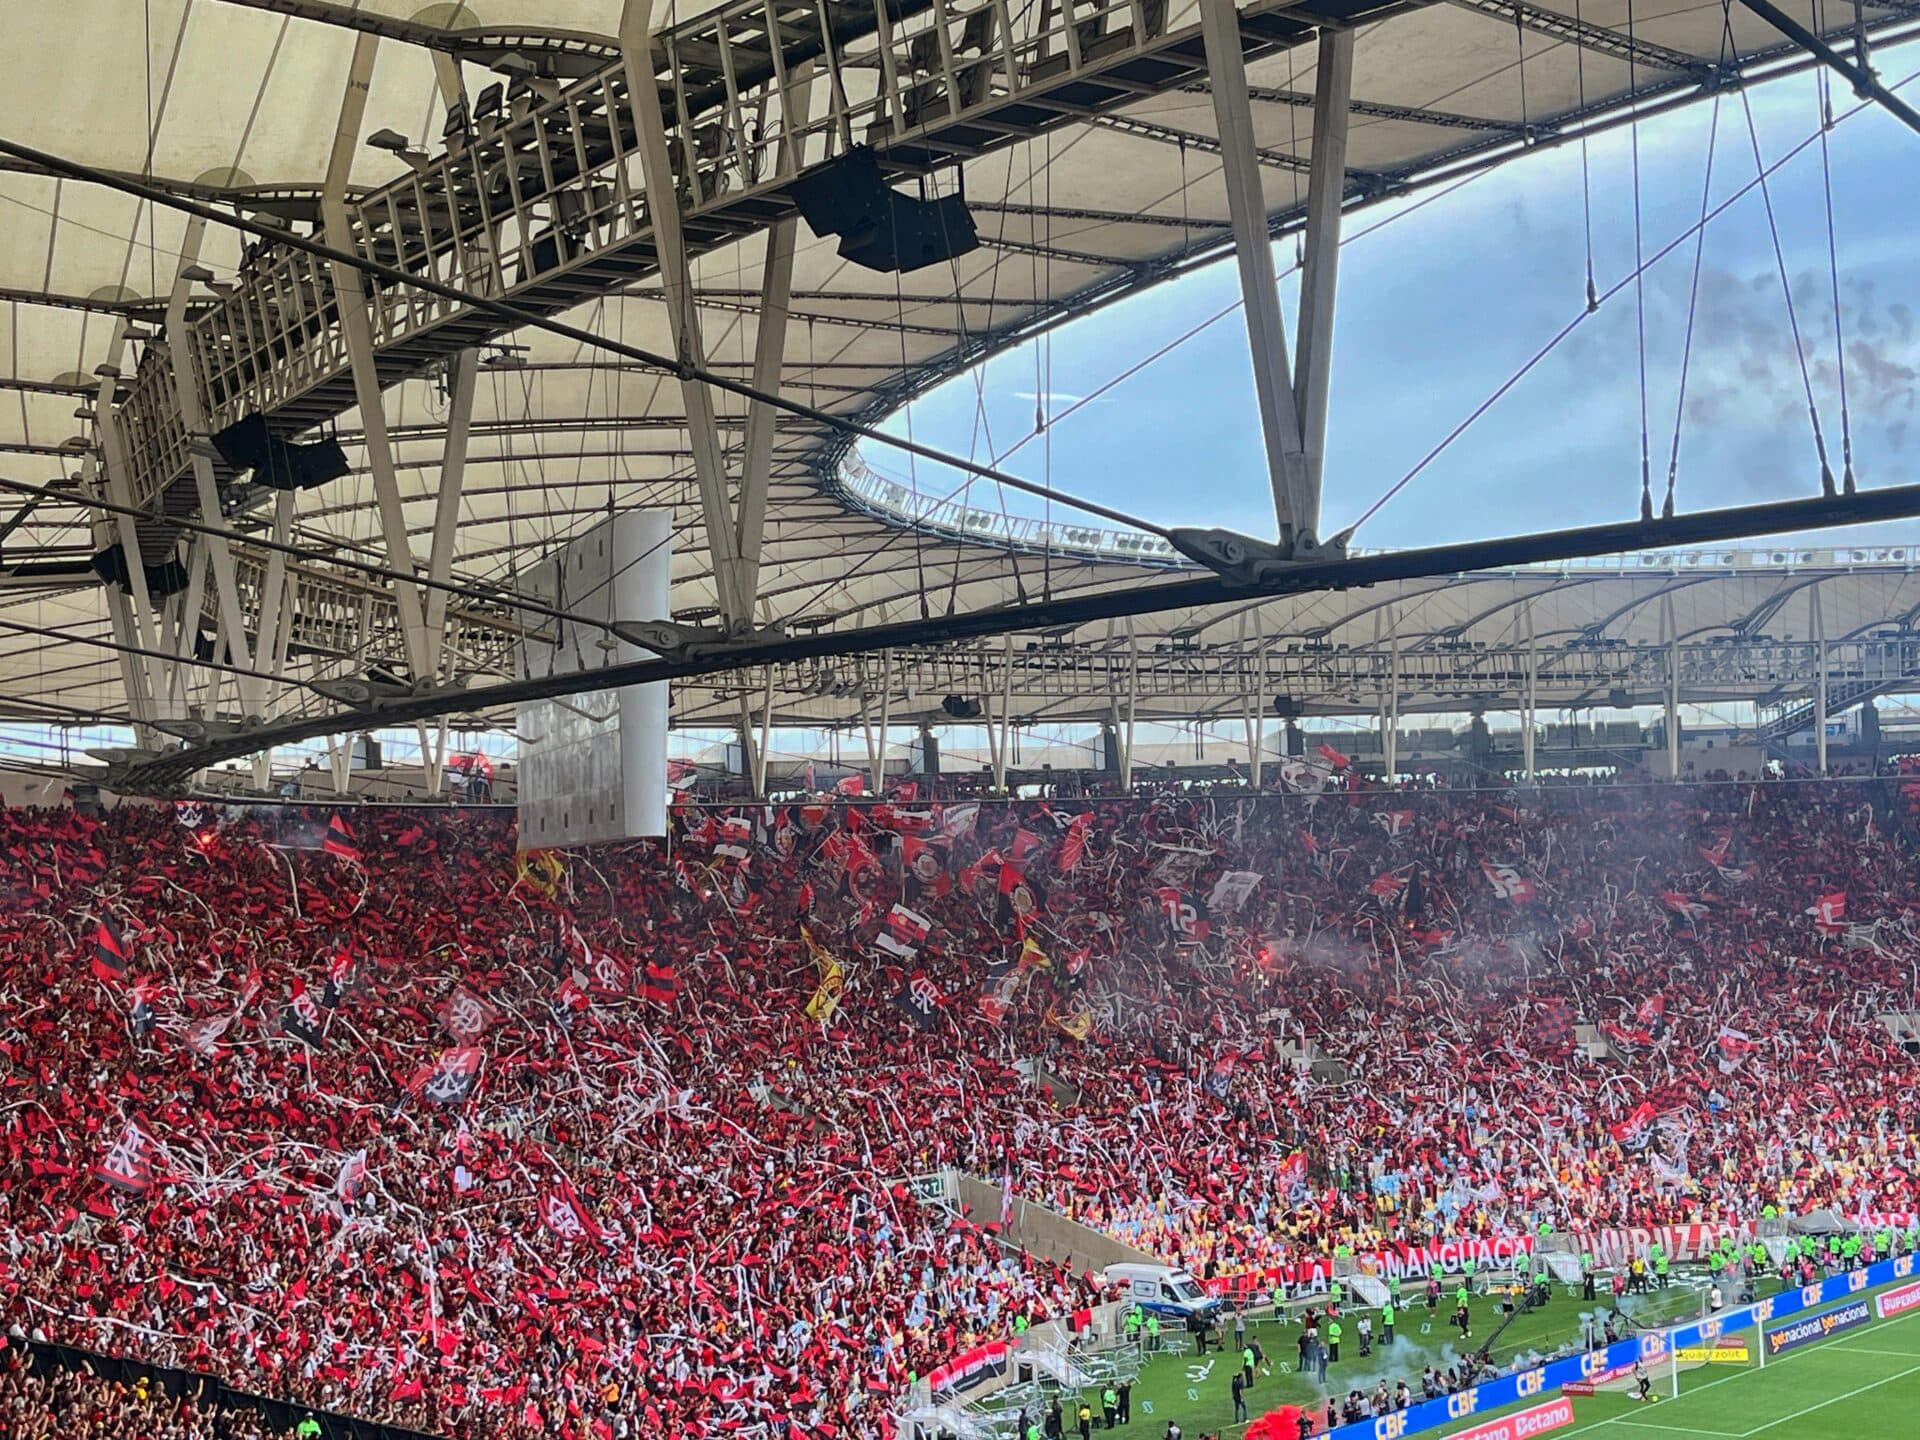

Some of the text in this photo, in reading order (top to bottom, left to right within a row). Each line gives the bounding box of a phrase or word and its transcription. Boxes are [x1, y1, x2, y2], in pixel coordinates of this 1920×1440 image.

[1168, 900, 1198, 936] 12
[1848, 1268, 1869, 1292] CBF
[1893, 1254, 1914, 1278] CBF
[1802, 1281, 1823, 1307] CBF
[1751, 1298, 1775, 1322] CBF
[1581, 1349, 1609, 1377] CBF
[1516, 1367, 1546, 1398] CBF
[1561, 1382, 1593, 1393] Betano
[1447, 1387, 1479, 1419] CBF
[1375, 1409, 1408, 1440] CBF
[1515, 1405, 1569, 1438] Betano
